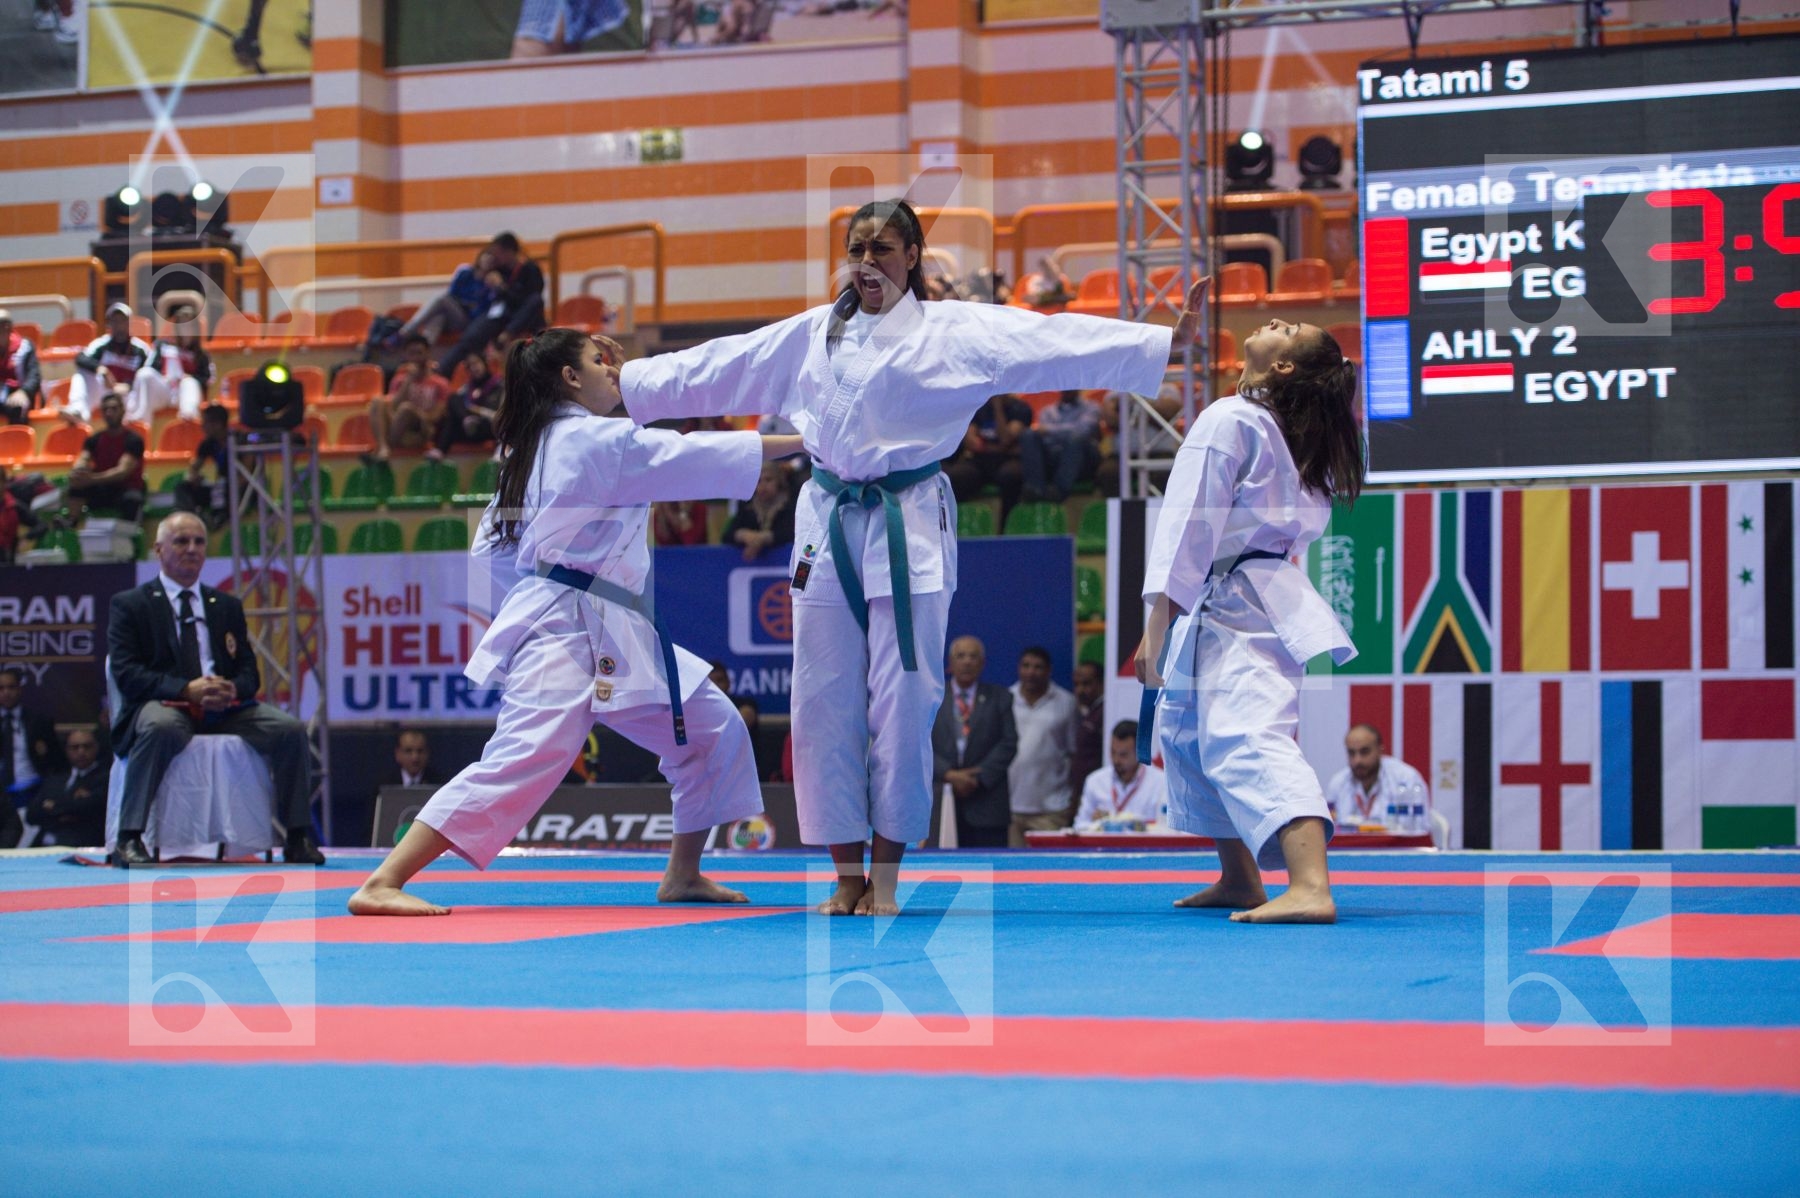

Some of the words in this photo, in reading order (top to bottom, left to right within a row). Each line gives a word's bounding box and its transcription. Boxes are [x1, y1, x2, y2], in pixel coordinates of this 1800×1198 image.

[1357, 61, 1493, 100] Tatami
[1505, 59, 1530, 90] 5
[1366, 176, 1516, 212] Female
[1421, 224, 1542, 265] Egypt
[1554, 219, 1586, 250] K
[1523, 266, 1586, 298] EG
[1422, 327, 1540, 360] AHLY
[1552, 325, 1577, 355] 2
[1525, 367, 1677, 403] EGYPT
[343, 583, 421, 618] Shell
[342, 622, 472, 667] HELI
[343, 673, 505, 712] ULTRA
